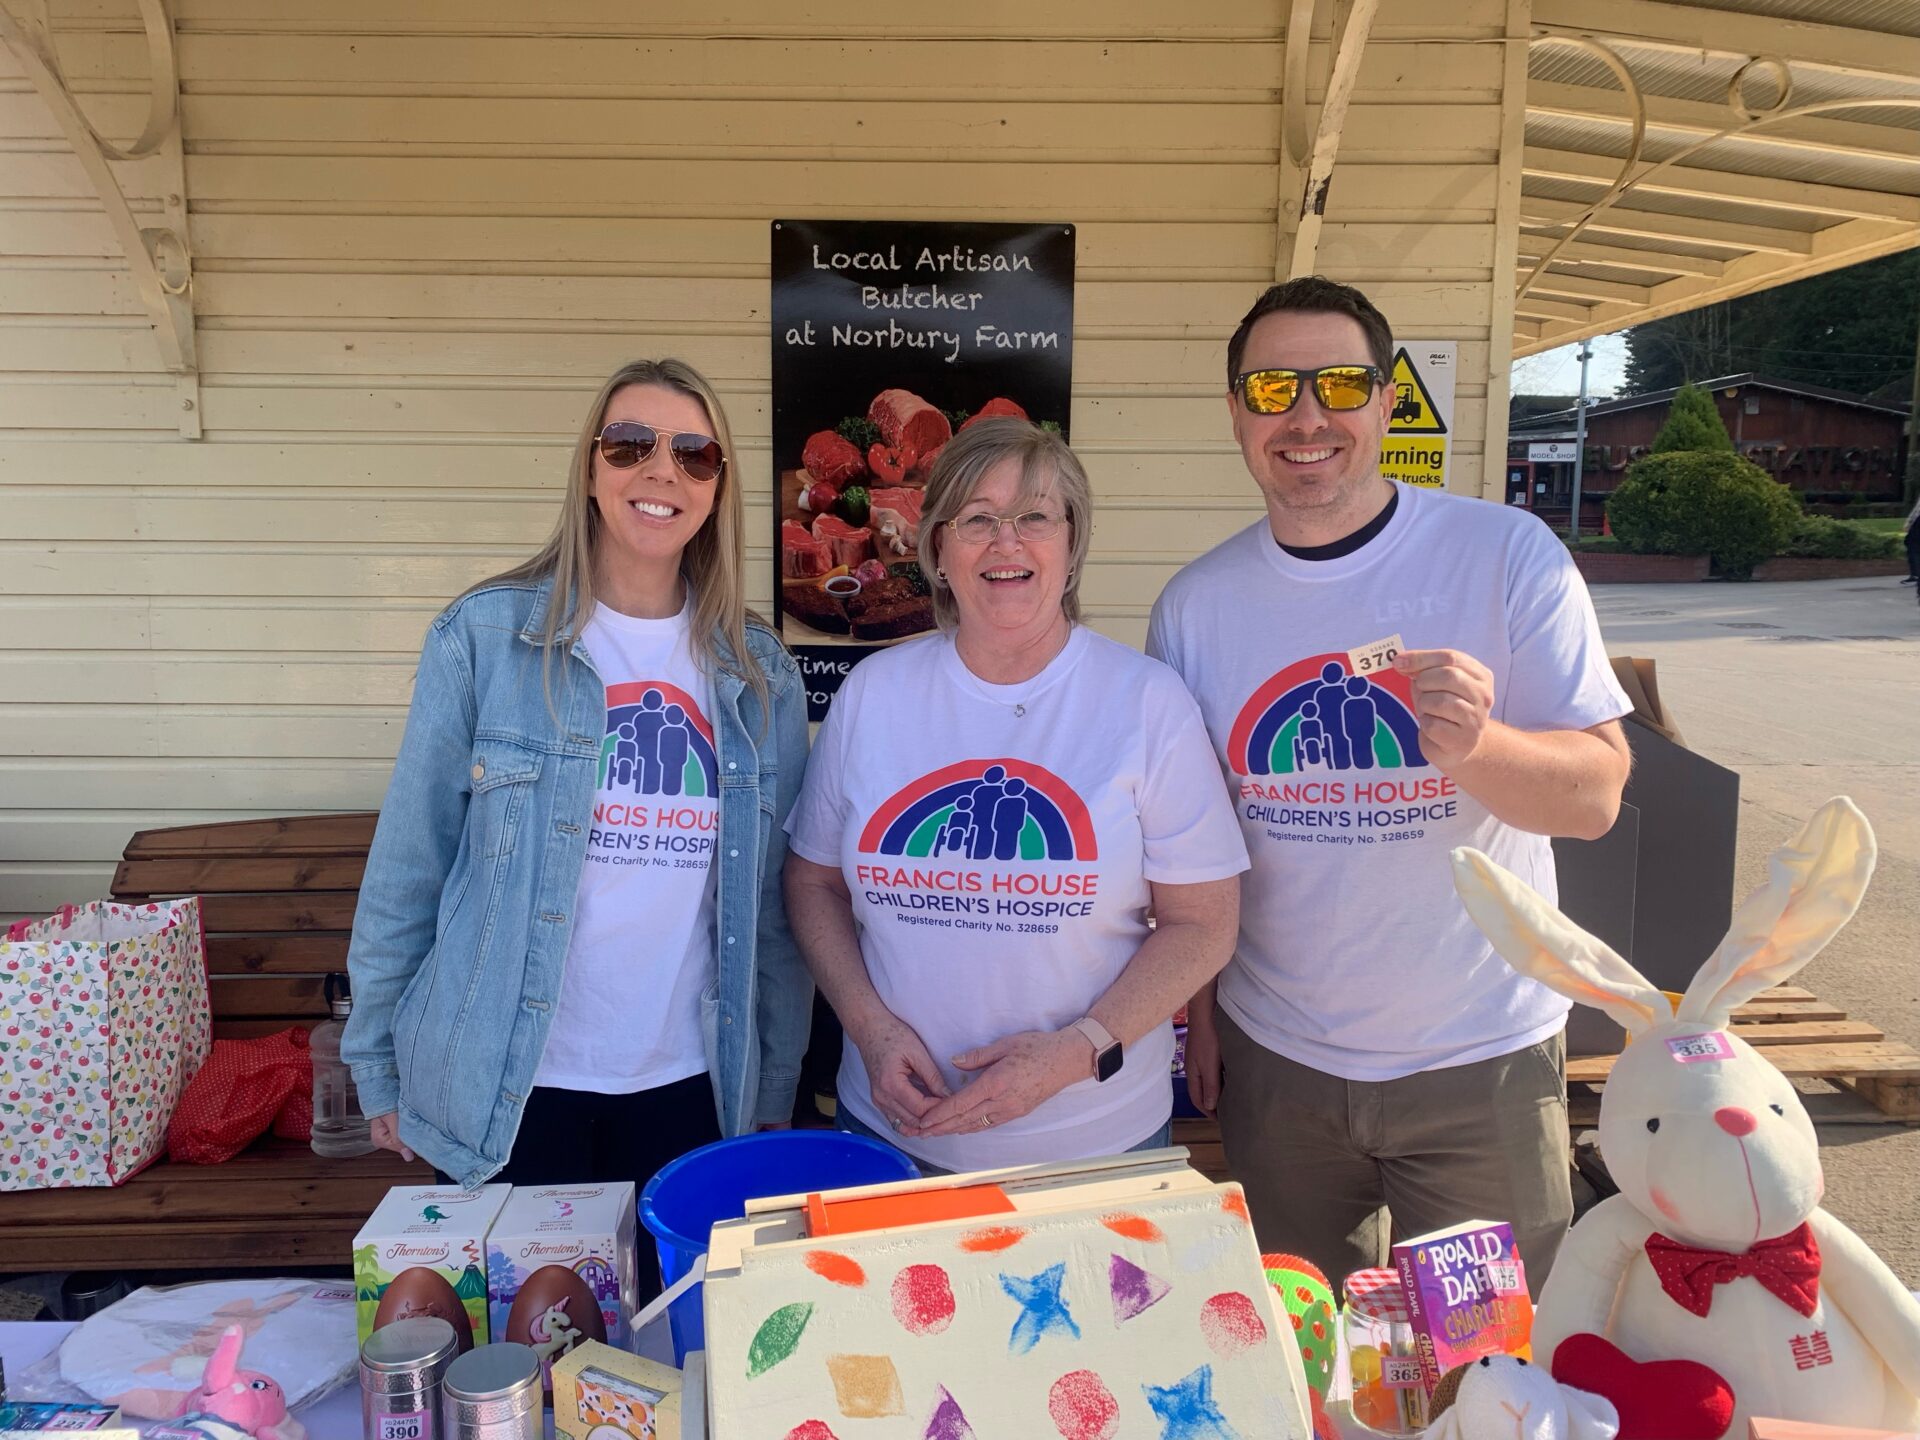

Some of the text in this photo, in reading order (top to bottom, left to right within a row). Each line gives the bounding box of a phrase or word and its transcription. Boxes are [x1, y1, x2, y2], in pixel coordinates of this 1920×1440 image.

[812, 244, 1034, 273] Local Artisan
[862, 284, 984, 310] Butcher
[786, 318, 1059, 363] at Norbury Farm
[1402, 473, 1440, 483] trucks
[1359, 648, 1399, 670] 370
[1239, 777, 1457, 804] FRANCIS HOUSE
[1246, 801, 1457, 827] CHILDREN'S HOSPICE
[654, 836, 717, 853] HOSPI
[1267, 829, 1425, 845] Registered Charity No. 328659
[612, 855, 649, 867] Charity
[652, 858, 670, 867] No.
[673, 859, 709, 869] 328659
[856, 865, 1099, 896] FRANCIS HOUSE
[865, 891, 1095, 917] CHILDREN'S HOSPICE
[897, 914, 1059, 934] Registered Charity No. 328659
[1680, 1044, 1717, 1056] 335
[386, 1242, 448, 1261] Thorntons
[520, 1242, 583, 1260] Thorntons
[1428, 1232, 1502, 1276] ROALD
[1400, 1257, 1420, 1318] ROALD DAHL
[1441, 1263, 1494, 1307] DAH
[1445, 1300, 1504, 1340] CHARLIE
[1391, 1368, 1421, 1381] 365
[53, 1420, 86, 1429] 225
[385, 1425, 419, 1439] 390
